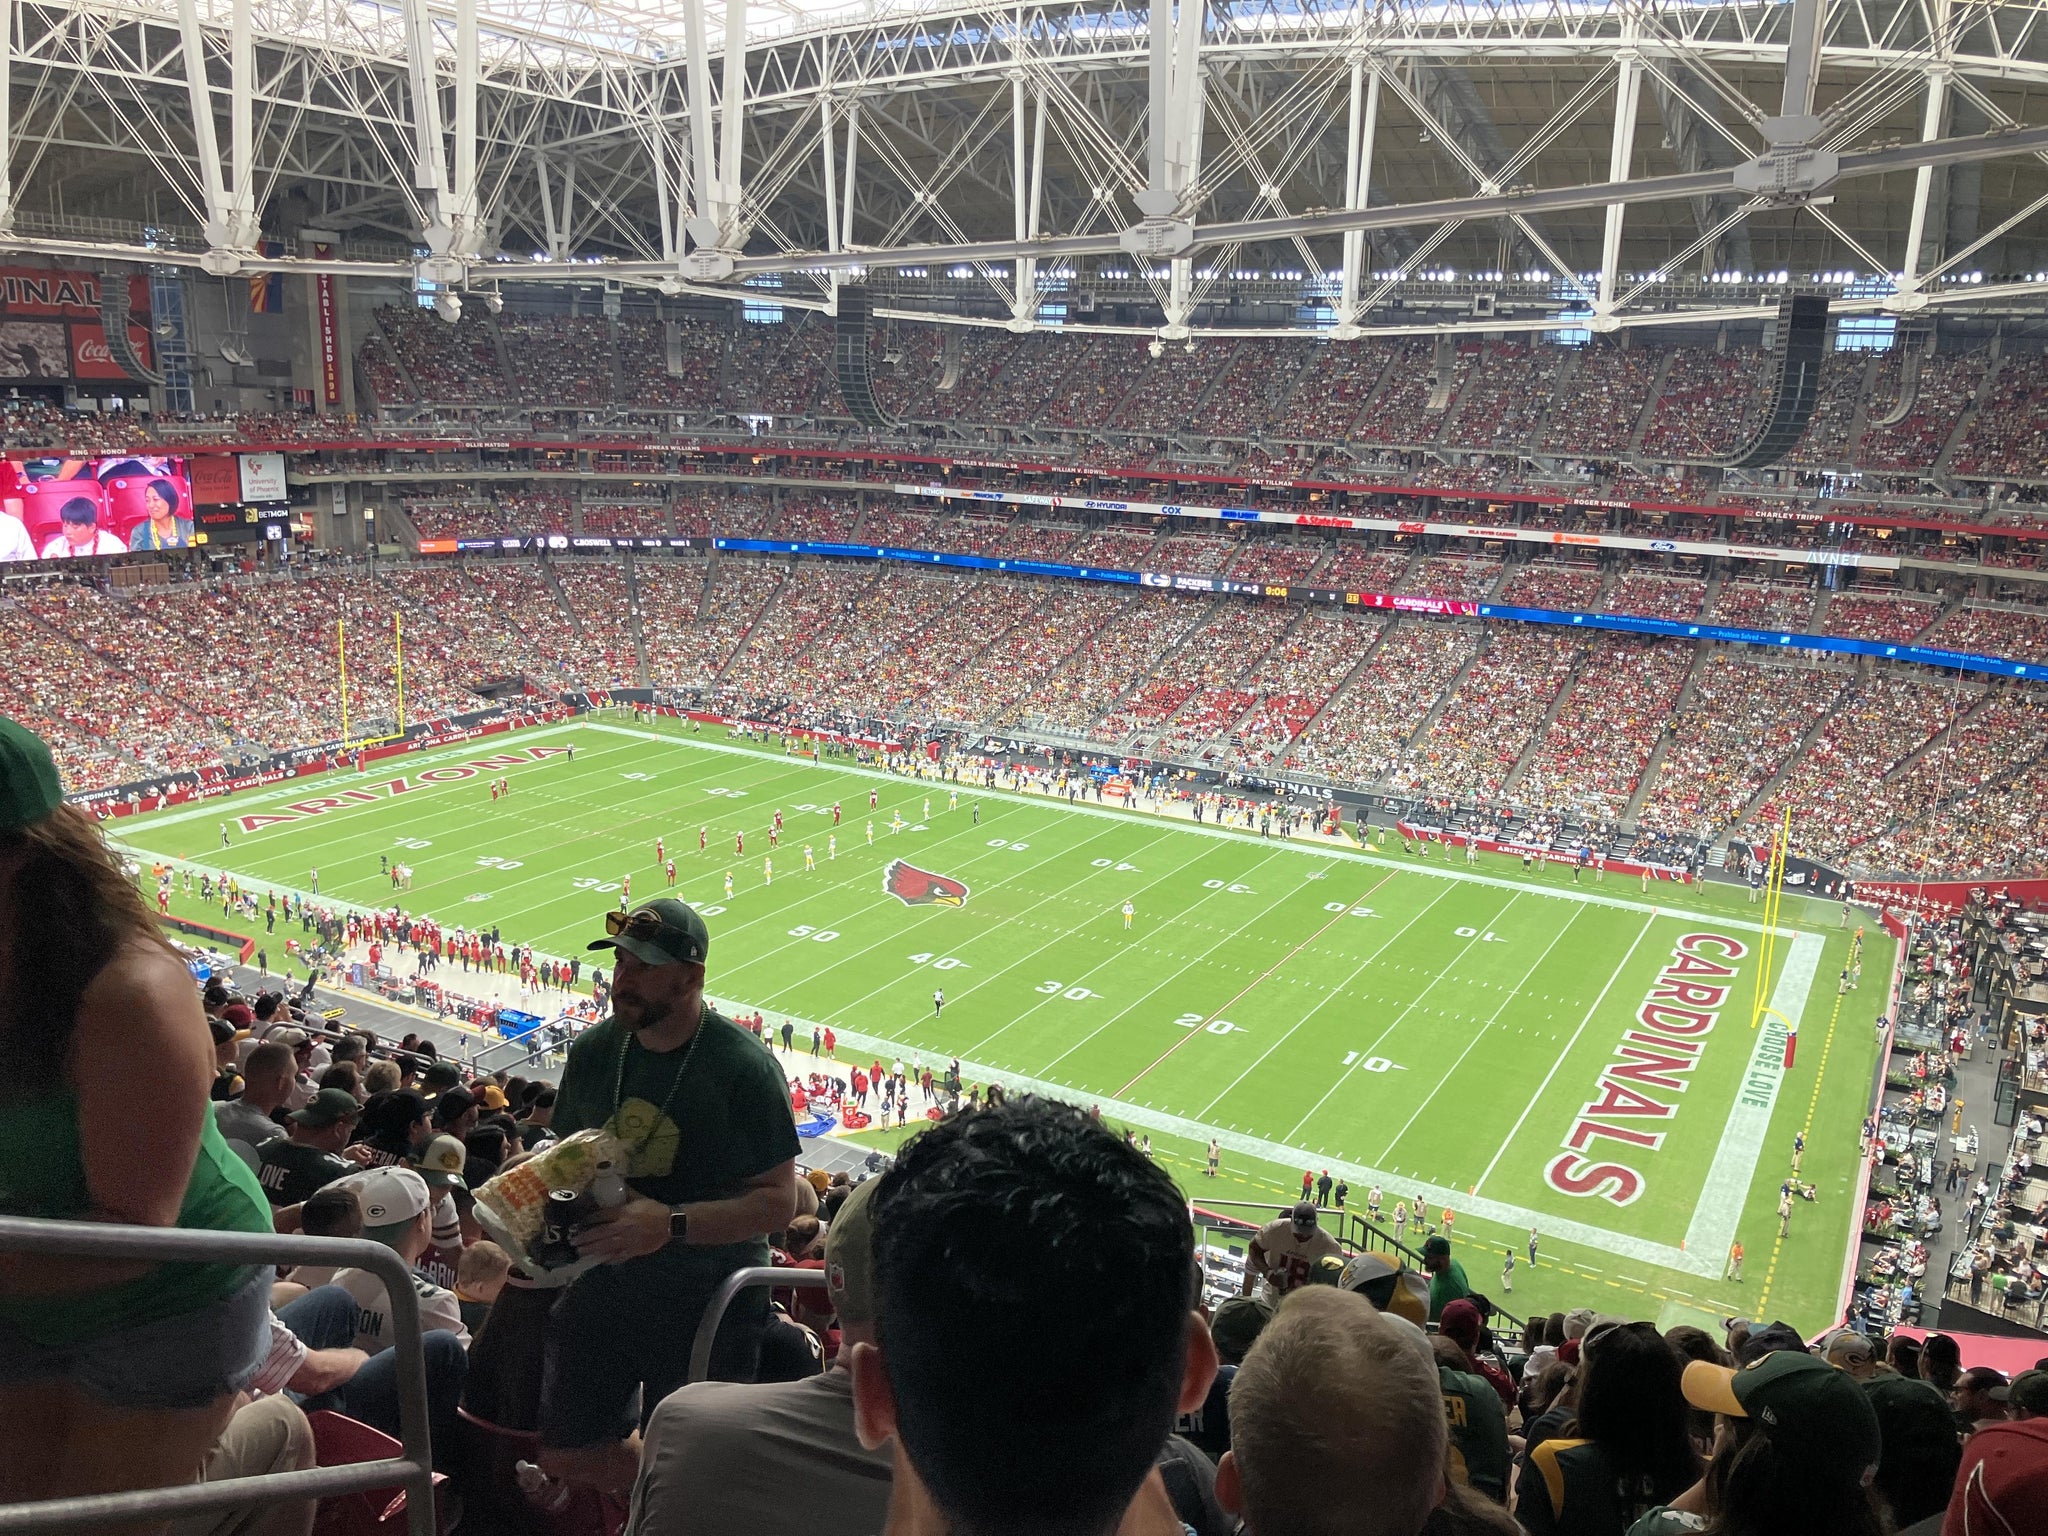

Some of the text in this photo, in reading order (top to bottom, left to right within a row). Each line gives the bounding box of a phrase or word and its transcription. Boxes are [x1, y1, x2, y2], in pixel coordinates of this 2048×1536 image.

[952, 459, 977, 467] CHARLES
[248, 478, 277, 487] University
[1265, 479, 1293, 487] TILLMAN
[1023, 495, 1051, 505] SAFEWAY
[1600, 500, 1630, 508] WEHRLI
[1096, 502, 1127, 510] HYUNDAI
[1161, 506, 1182, 514] COX
[201, 513, 237, 524] verizon
[258, 509, 289, 519] BETMGM
[1754, 510, 1793, 519] CHARLEY
[1795, 513, 1824, 521] TRIPPI
[1806, 551, 1860, 566] AVNET
[1177, 576, 1213, 588] PACKERS
[1222, 582, 1230, 591] 3
[1265, 586, 1288, 597] 9:06
[1374, 596, 1383, 606] 3
[1392, 598, 1444, 609] CARDINALS
[443, 728, 483, 742] CARDIALS
[291, 747, 324, 758] ARIZONA
[233, 772, 284, 789] CARDNALS
[231, 746, 587, 834] ARIZONA
[71, 788, 120, 804] CARDINALS
[1542, 932, 1749, 1207] CARDINALS
[1741, 1022, 1790, 1109] CHOOSE LOVE
